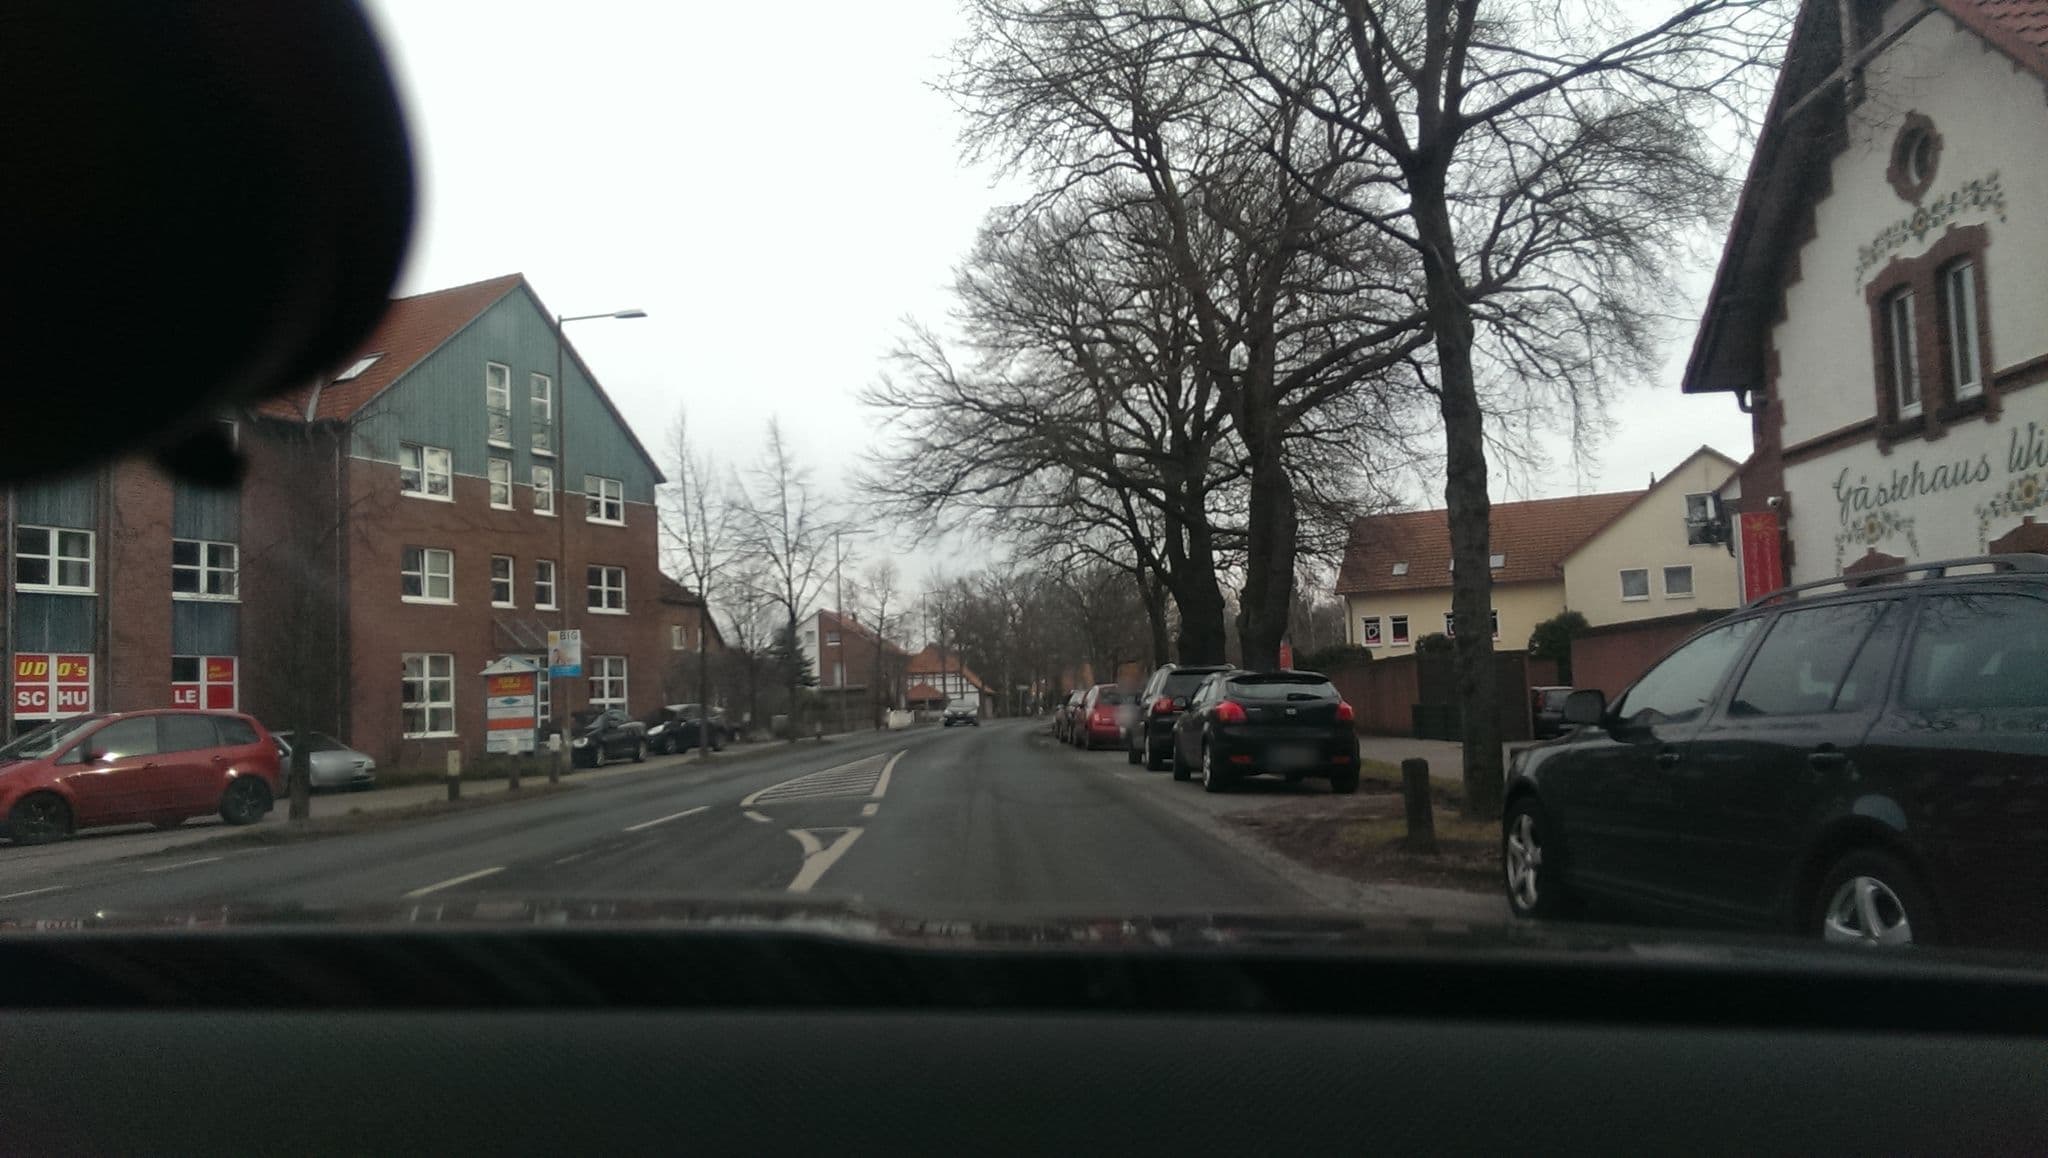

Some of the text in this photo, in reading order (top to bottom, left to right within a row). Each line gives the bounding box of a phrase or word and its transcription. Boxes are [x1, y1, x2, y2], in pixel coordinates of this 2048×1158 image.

[1832, 422, 2048, 525] Gästehaus Wi
[174, 690, 197, 704] LE
